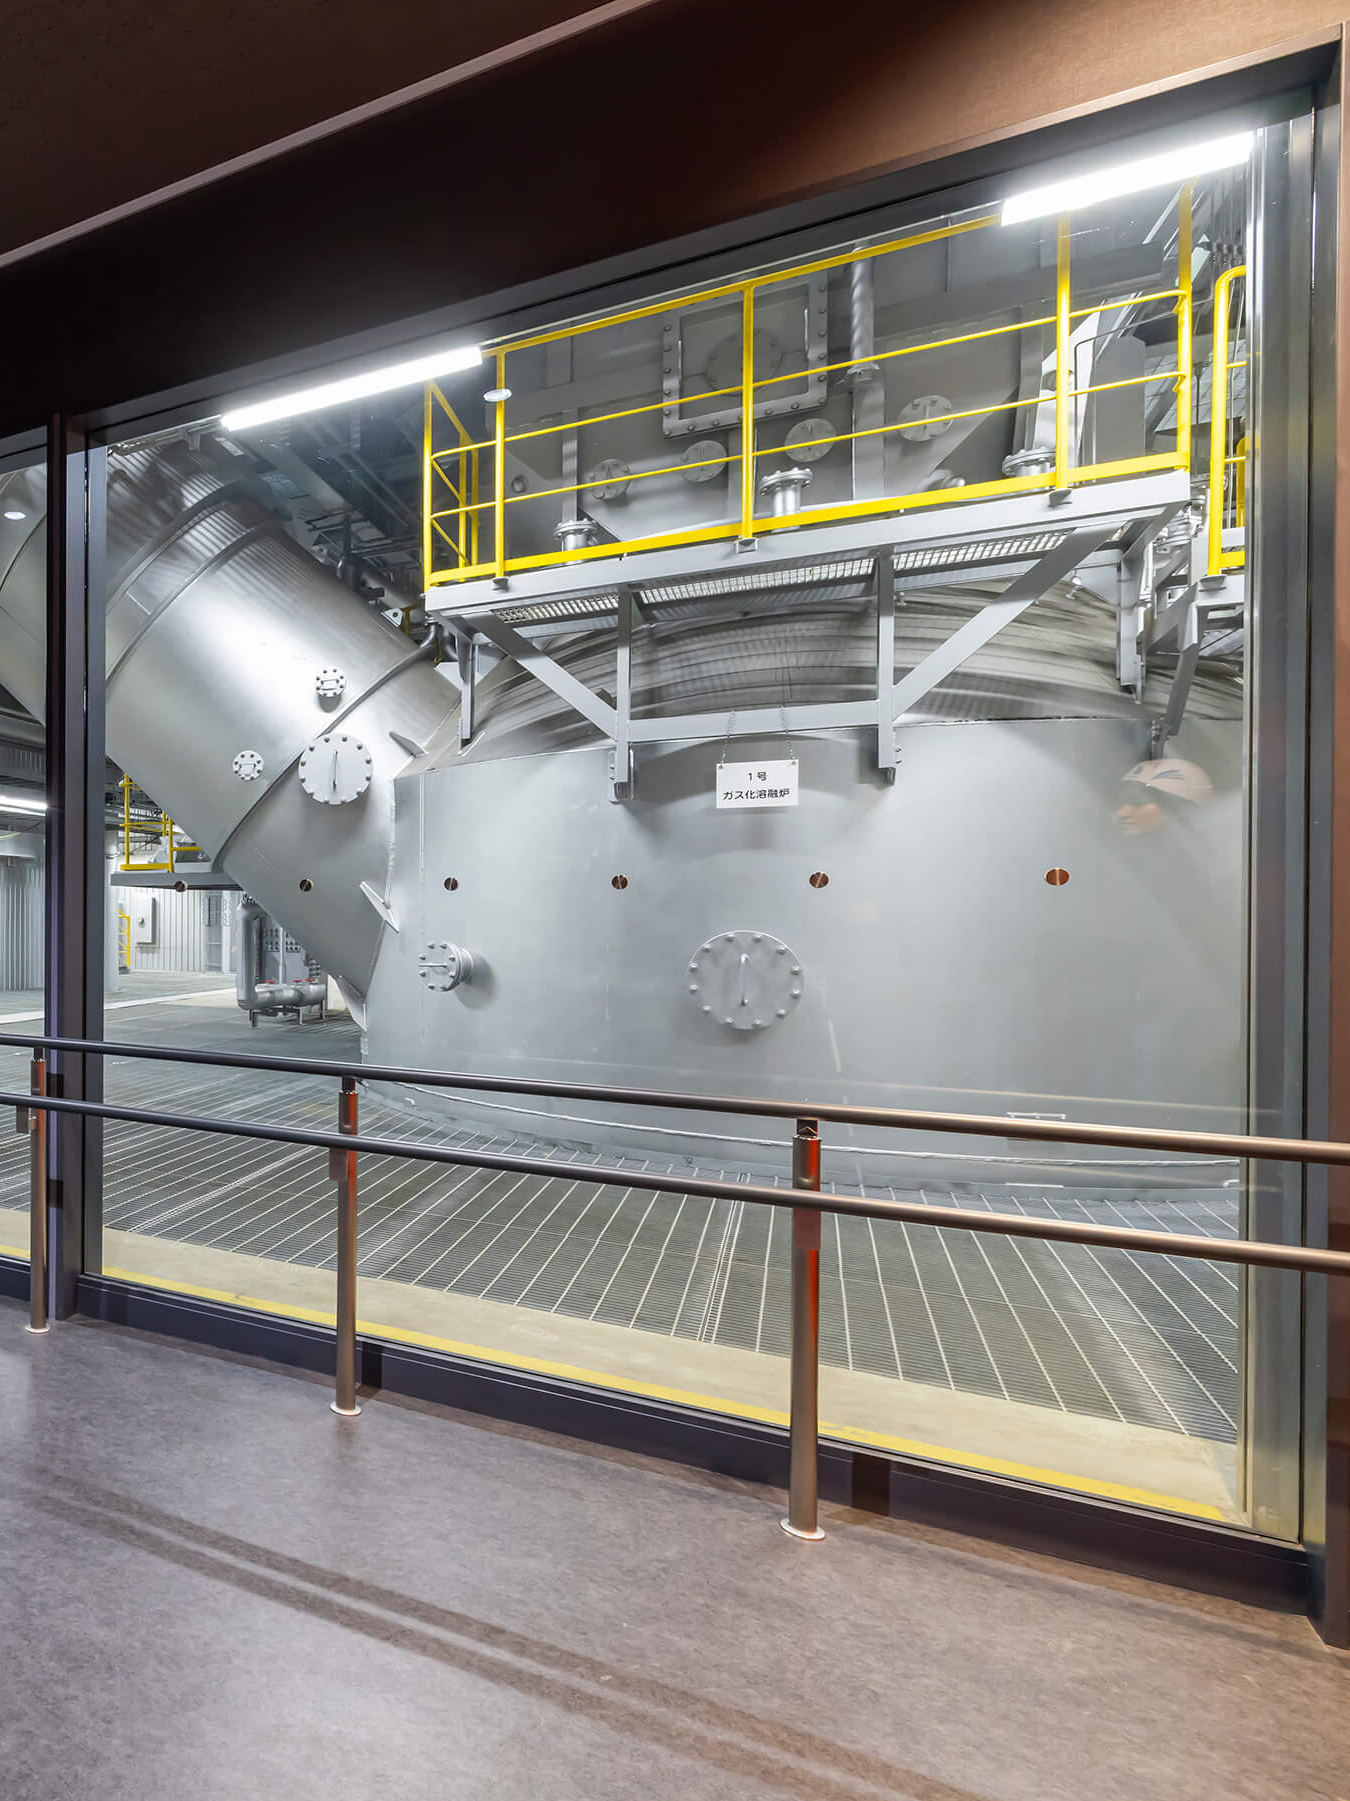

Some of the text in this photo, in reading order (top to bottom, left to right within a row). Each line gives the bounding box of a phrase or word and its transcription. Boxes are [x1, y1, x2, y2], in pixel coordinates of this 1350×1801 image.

[723, 788, 790, 800] ガス化溶融炉
